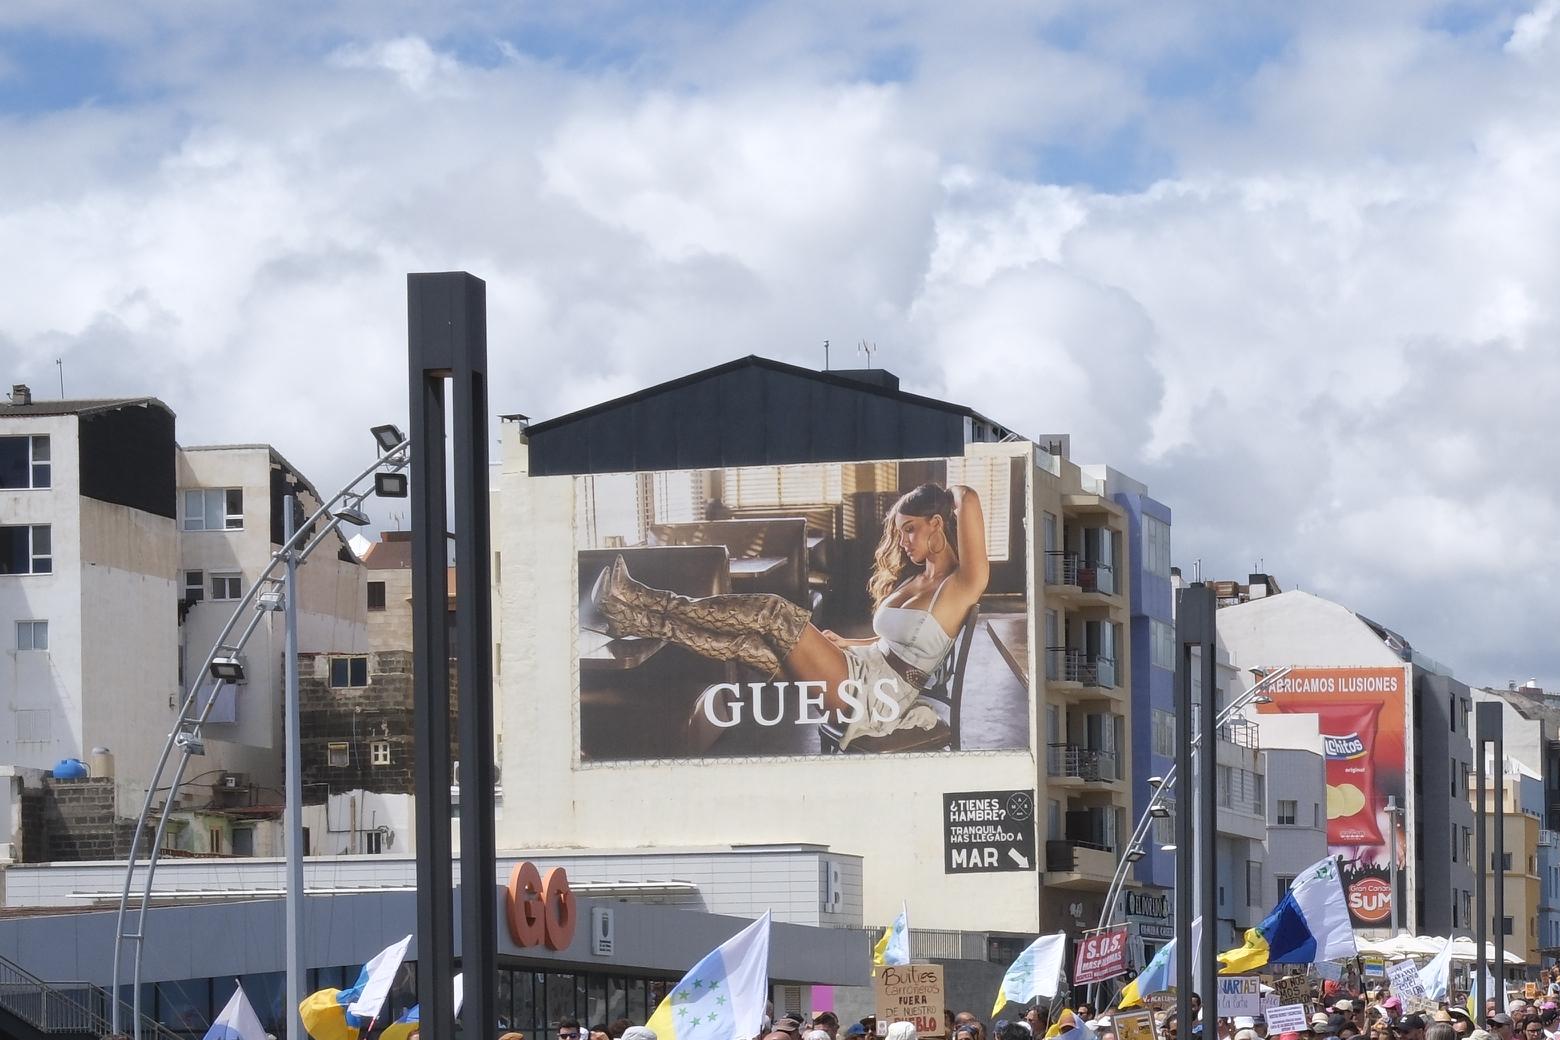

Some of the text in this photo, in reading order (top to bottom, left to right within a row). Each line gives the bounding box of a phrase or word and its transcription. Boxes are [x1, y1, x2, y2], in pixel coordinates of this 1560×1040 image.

[1338, 677, 1398, 692] ILUSIONES
[703, 677, 901, 728] GUESS
[950, 799, 1000, 811] ¿TIENES
[950, 809, 1007, 822] HAMBRE?
[950, 825, 1003, 835] TRANQUILA
[950, 831, 1023, 843] HAS LLEGADO A
[951, 847, 999, 868] MAR
[1350, 885, 1367, 893] Gran
[506, 861, 577, 951] GO
[1350, 892, 1393, 911] SUM
[1086, 934, 1121, 959] S.O.S.
[1275, 975, 1305, 990] NO NOS
[899, 994, 928, 1006] FUERA
[885, 1007, 898, 1018] DE
